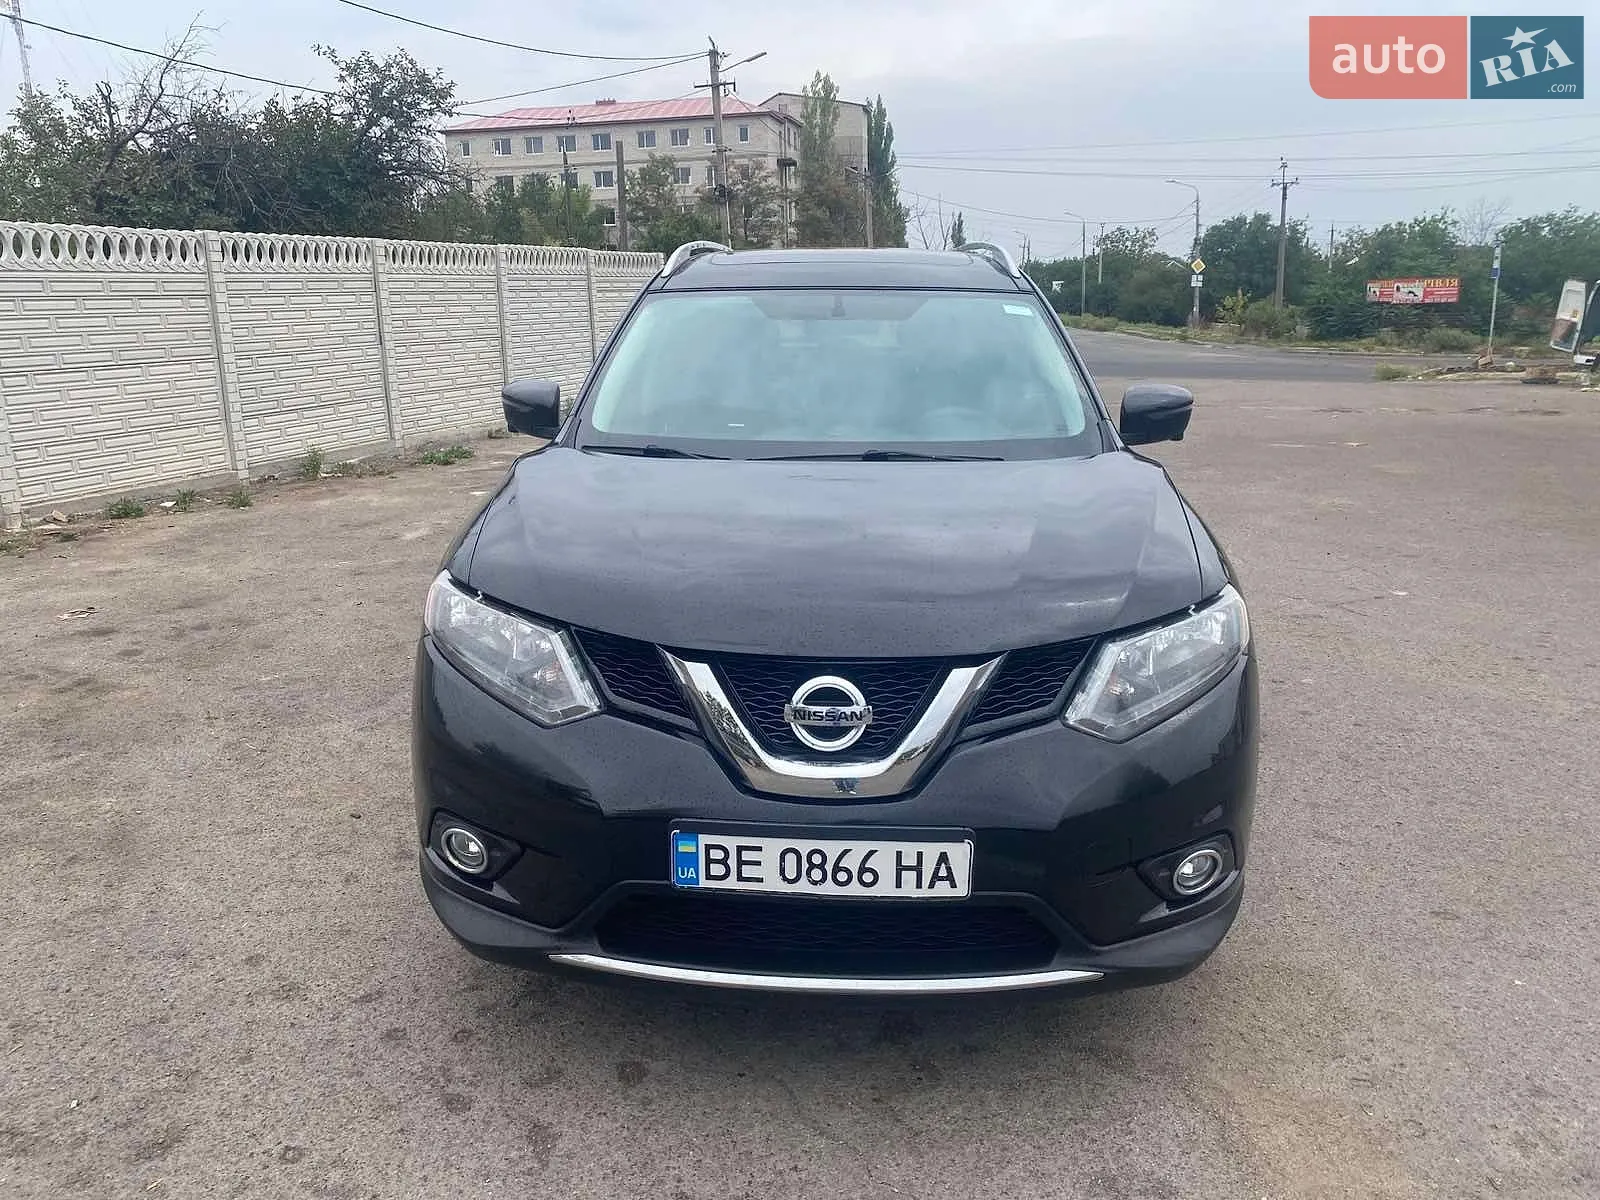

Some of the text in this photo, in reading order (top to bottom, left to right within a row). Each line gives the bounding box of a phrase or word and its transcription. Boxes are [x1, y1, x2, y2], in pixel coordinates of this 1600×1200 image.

[793, 711, 862, 721] NISSAN
[703, 843, 958, 889] BE 0866 HA
[678, 867, 696, 879] UA
